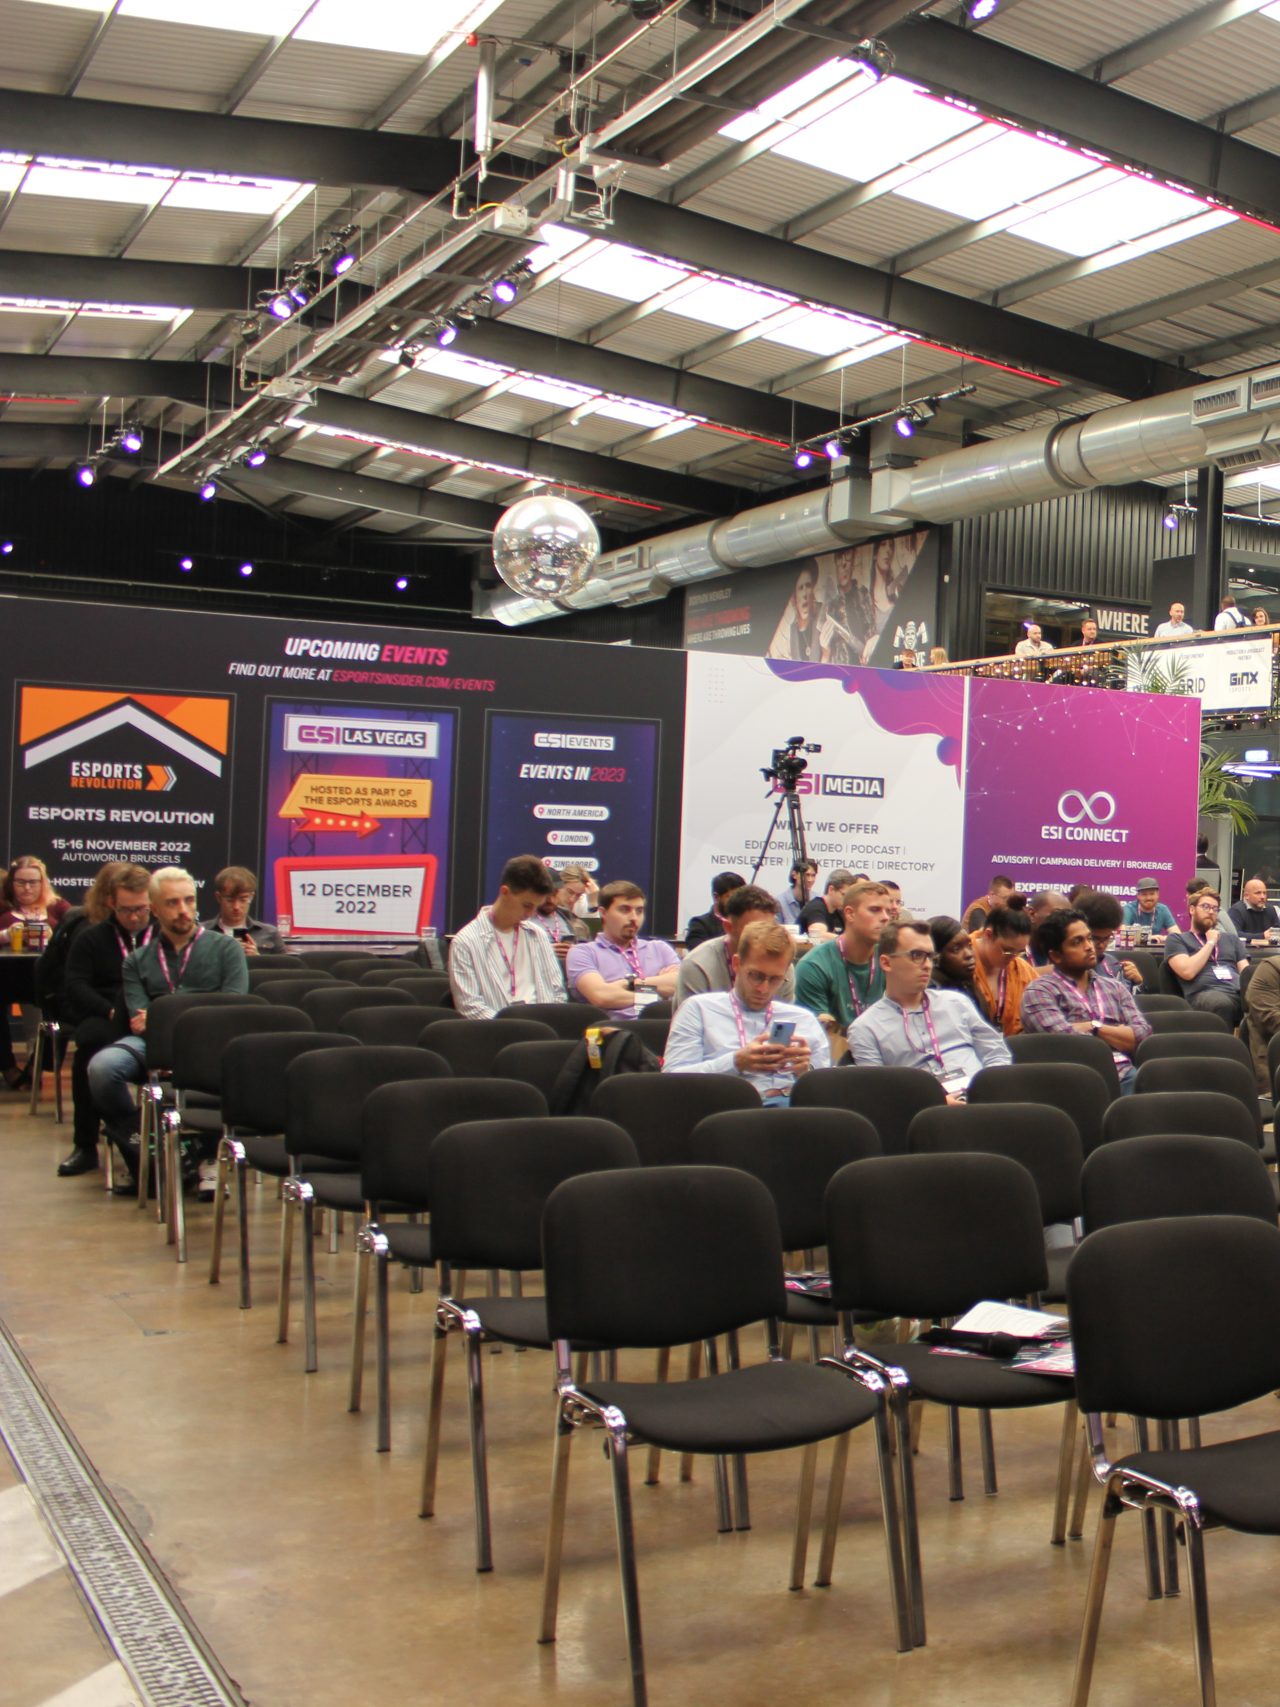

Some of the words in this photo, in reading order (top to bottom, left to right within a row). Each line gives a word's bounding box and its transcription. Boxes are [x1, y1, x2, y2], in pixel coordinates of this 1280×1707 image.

[1096, 609, 1149, 635] WHERE
[285, 637, 380, 662] UPCOMING
[381, 644, 449, 667] EVENTS
[228, 662, 256, 677] FIND
[257, 664, 282, 678] OUT
[283, 666, 316, 681] MORE
[317, 669, 333, 682] AT
[332, 669, 496, 692] ESPORTSINSIDER.COM/EVENTS
[297, 725, 341, 745] ESI
[344, 729, 373, 744] LAS
[374, 731, 424, 746] VEGAS
[533, 732, 566, 748] ESI
[568, 735, 612, 749] EVENTS
[71, 761, 143, 779] ESPORTS
[519, 763, 573, 780] EVENTS
[574, 766, 590, 781] IN
[590, 767, 627, 782] 2023
[70, 777, 143, 790] REVOLUTION
[310, 785, 353, 796] HOSTED
[355, 787, 368, 796] AS
[370, 787, 396, 797] PART
[398, 788, 412, 797] OF
[824, 776, 882, 796] MEDIA
[304, 795, 324, 805] THE
[326, 796, 372, 807] ESPORTS
[374, 798, 418, 808] AWARDS
[28, 806, 106, 822] ESPORTS
[109, 809, 214, 825] REVOLUTION
[546, 808, 572, 817] NORTH
[571, 808, 604, 818] AMERICA
[816, 821, 836, 834] WE
[838, 822, 879, 835] OFFER
[1041, 825, 1062, 840] ESI
[1065, 826, 1129, 843] CONNECT
[51, 838, 84, 850] 15-16
[86, 840, 157, 852] NOVEMBER
[159, 841, 191, 853] 2022
[560, 833, 589, 843] LONDON
[809, 843, 843, 853] VIDEO
[850, 844, 902, 856] PODCAST
[62, 852, 128, 863] AUTOWORLD
[130, 854, 181, 864] BRUSSELS
[991, 855, 1034, 865] ADVISORY
[1039, 857, 1083, 867] CAMPAIGN
[1083, 859, 1121, 869] DELIVERY
[1126, 860, 1173, 871] BROKERAGE
[876, 860, 935, 872] DIRECTORY
[299, 883, 316, 896] 12
[322, 883, 412, 898] DECEMBER
[335, 901, 377, 914] 2022
